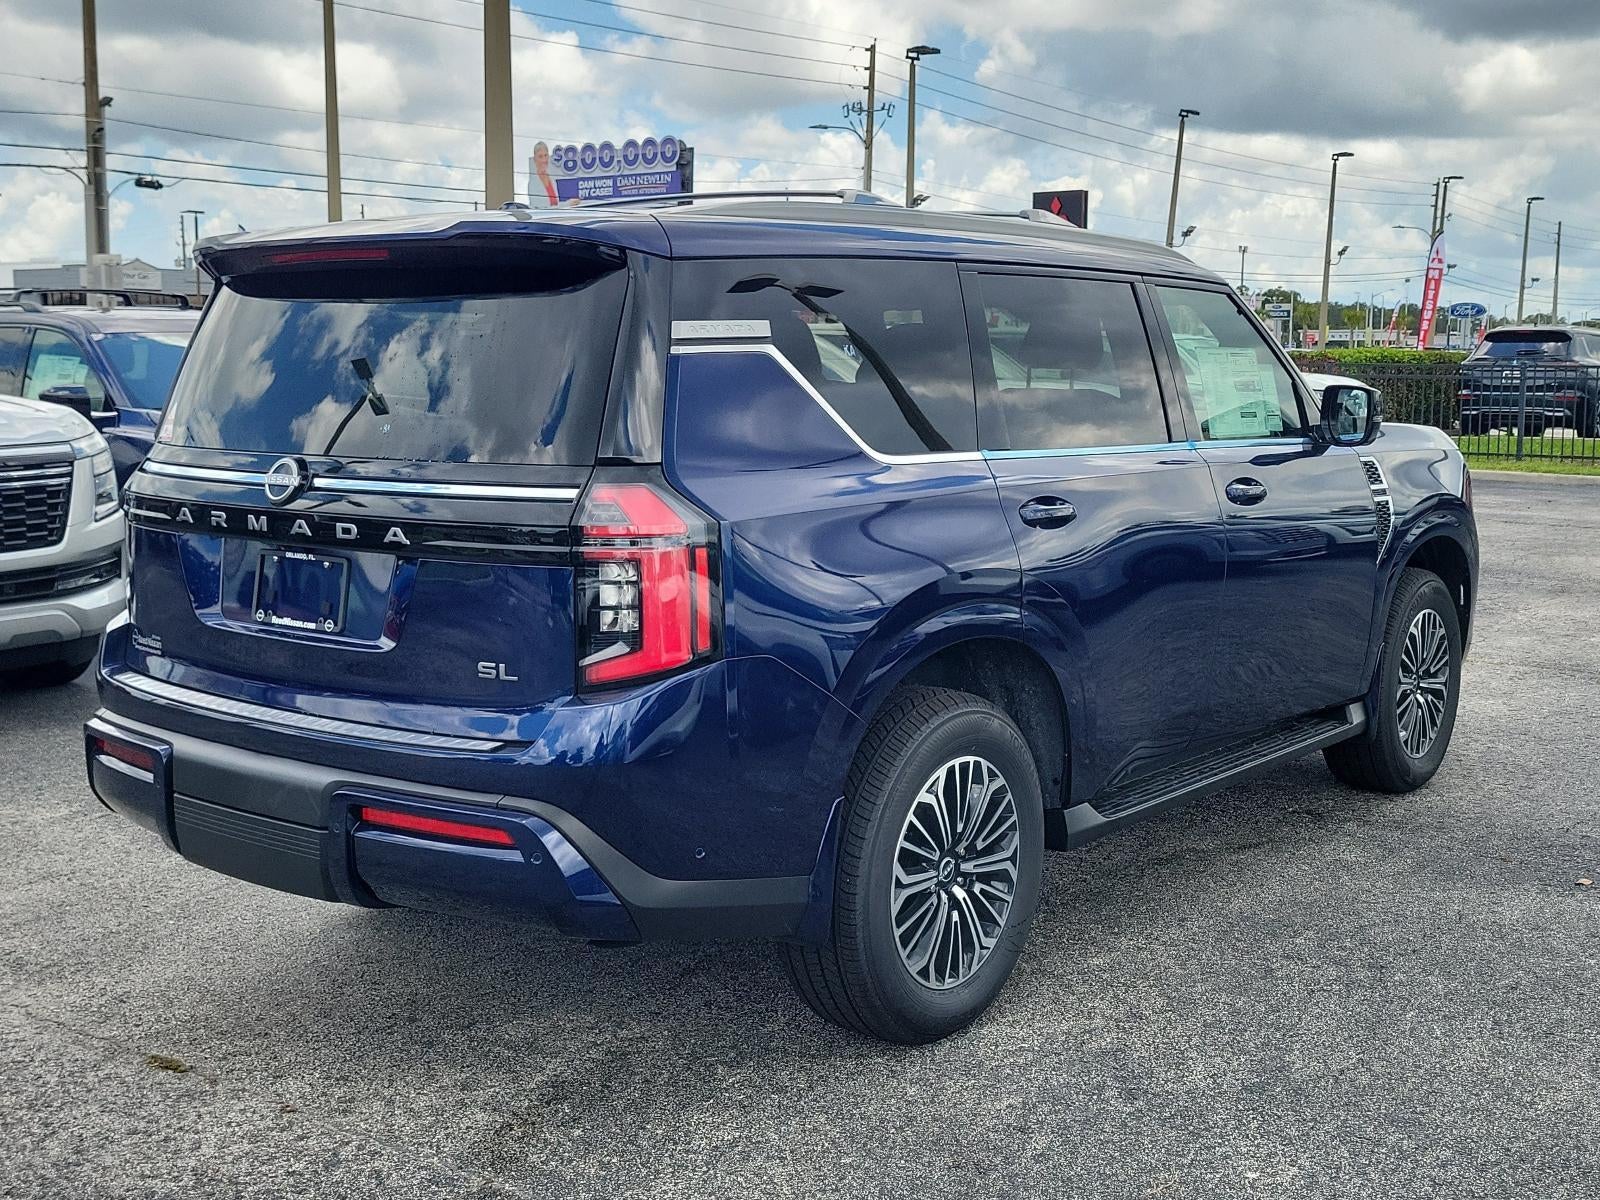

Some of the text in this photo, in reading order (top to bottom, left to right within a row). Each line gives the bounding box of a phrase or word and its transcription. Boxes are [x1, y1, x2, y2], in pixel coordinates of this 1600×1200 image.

[553, 136, 678, 173] $800,000
[578, 178, 613, 189] DAN WON
[617, 176, 635, 186] DAN
[175, 507, 411, 545] ARMADA
[477, 661, 519, 681] SL
